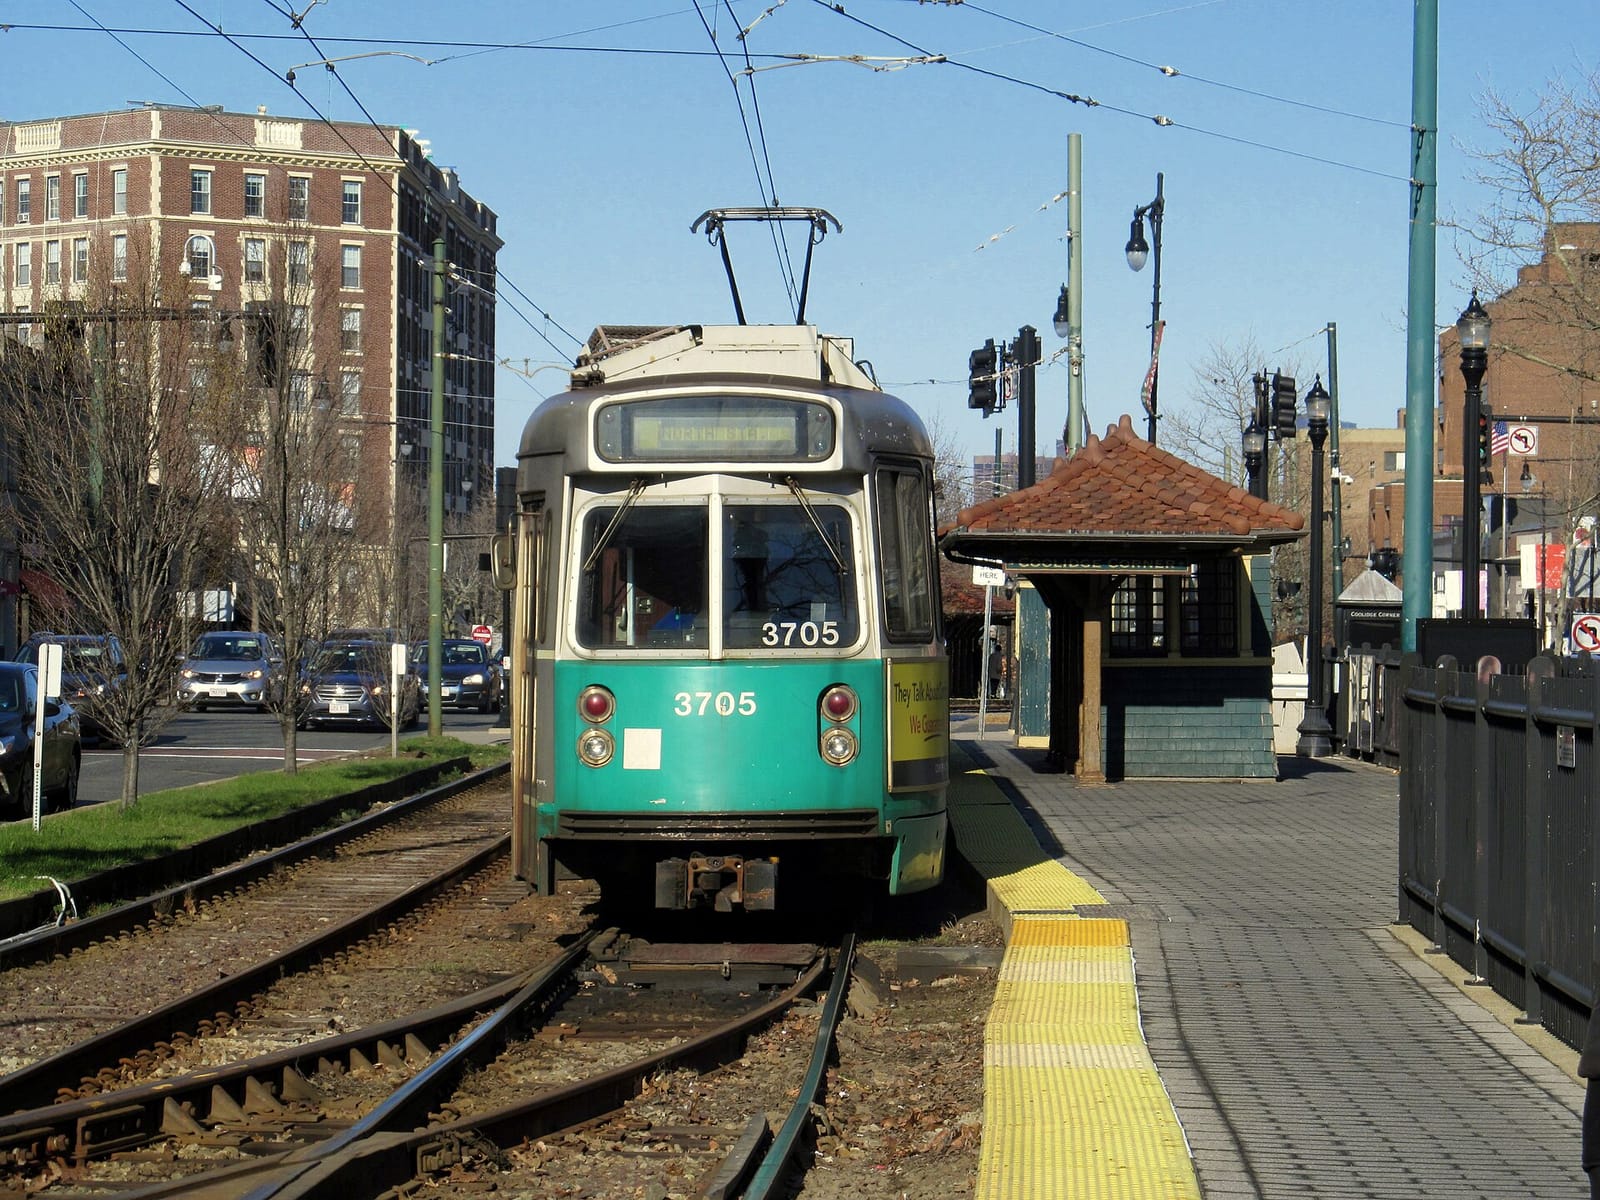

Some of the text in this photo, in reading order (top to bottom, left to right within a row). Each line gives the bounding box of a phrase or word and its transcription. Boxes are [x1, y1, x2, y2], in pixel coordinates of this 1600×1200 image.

[1018, 558, 1176, 569] COOLIDGE CORNER
[761, 621, 840, 646] 3705
[674, 691, 757, 717] 3705
[894, 681, 911, 708] They
[911, 681, 925, 702] Talk
[909, 714, 921, 734] We
